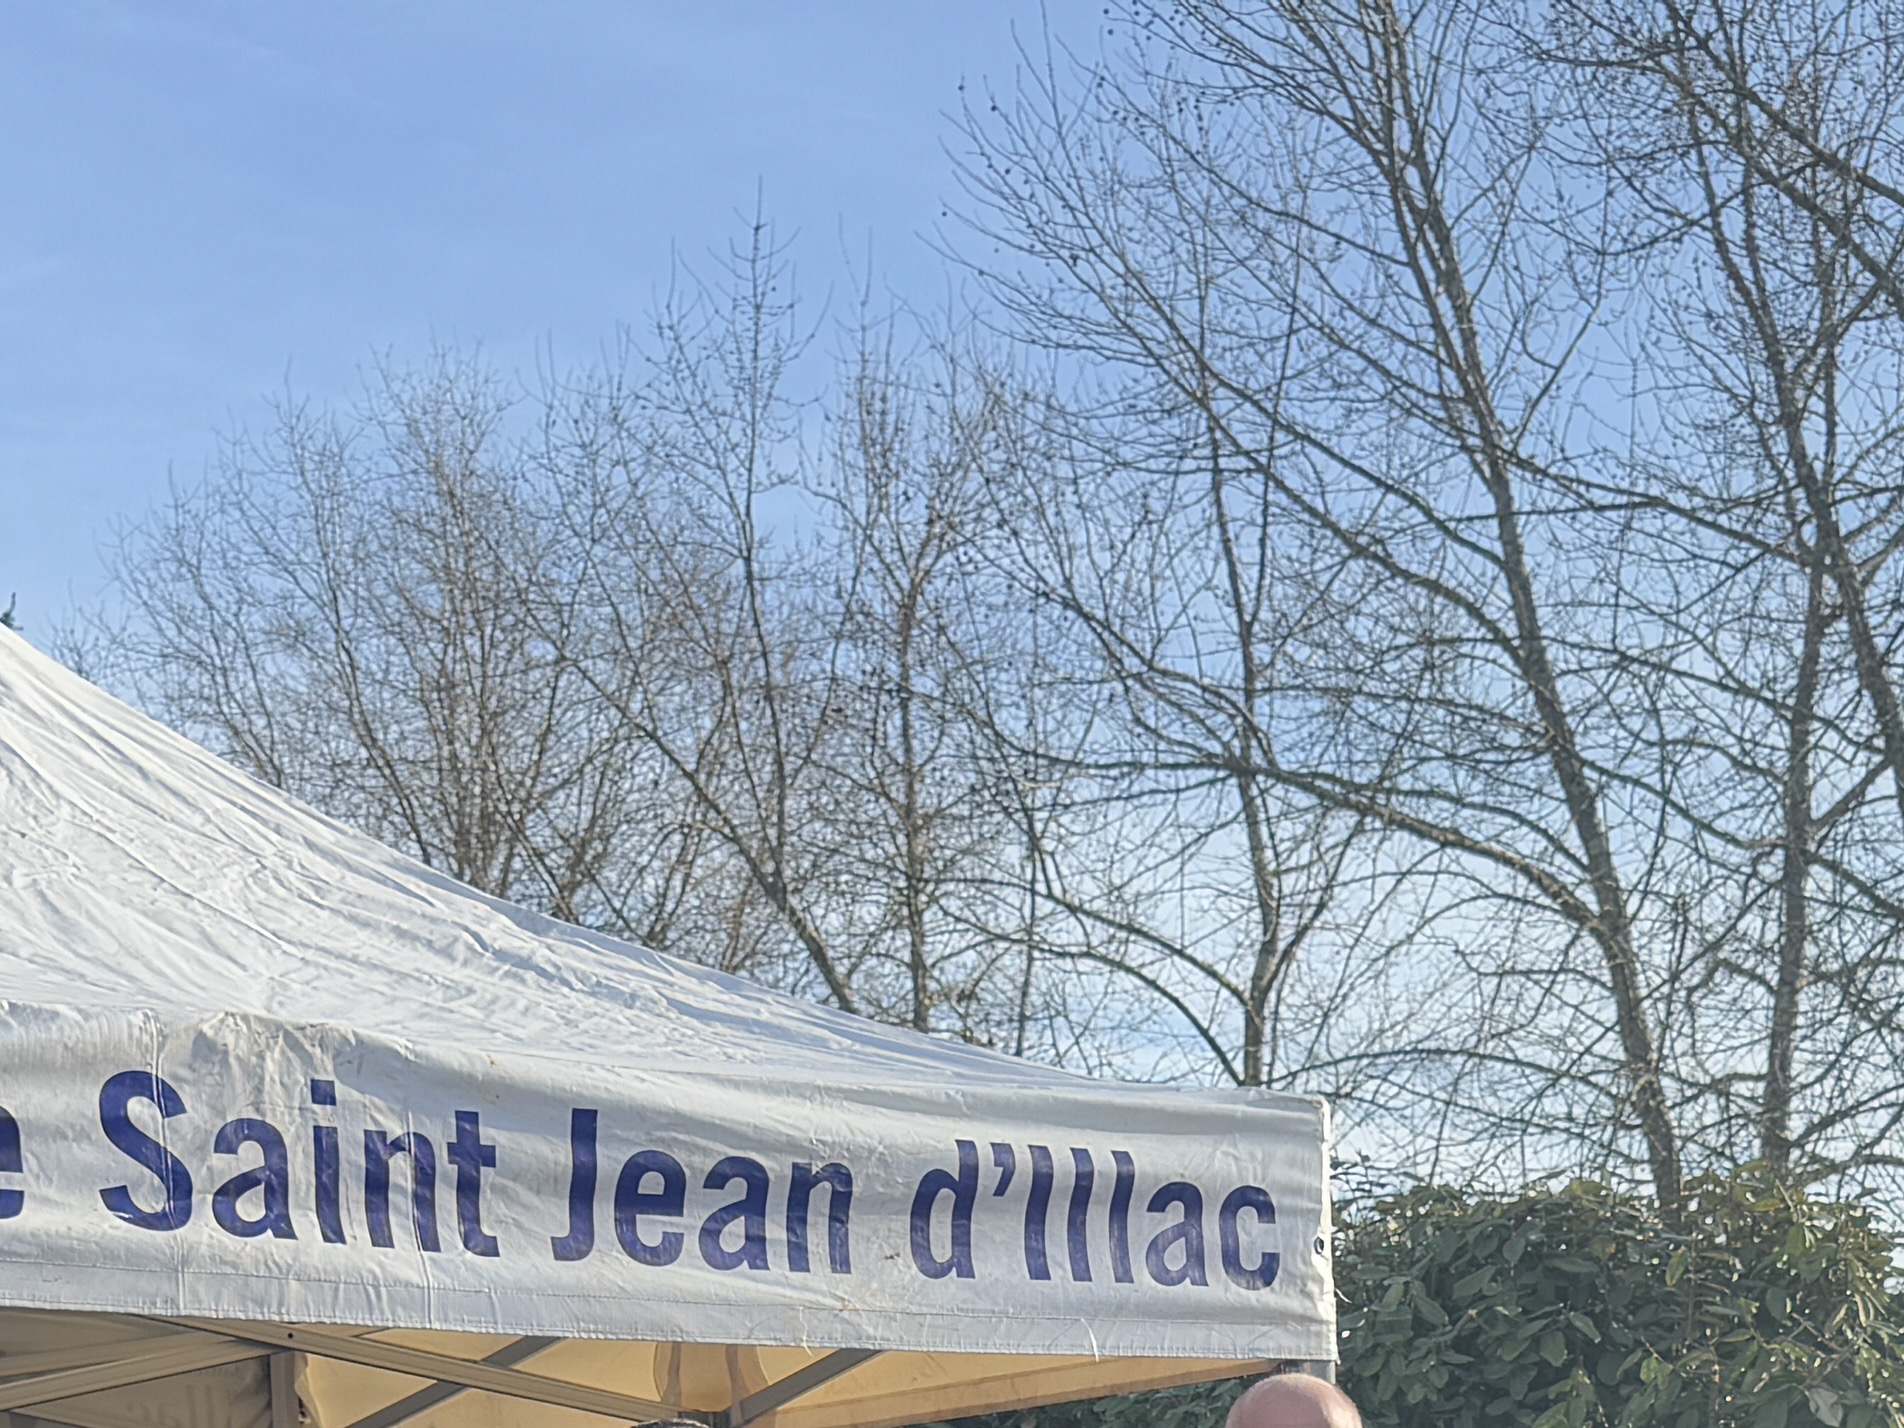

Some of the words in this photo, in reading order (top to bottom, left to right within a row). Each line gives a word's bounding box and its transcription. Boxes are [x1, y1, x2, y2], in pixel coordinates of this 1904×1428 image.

[97, 1070, 500, 1258] Saint
[551, 1107, 854, 1275] Jean
[909, 1138, 1280, 1292] d'Illac
